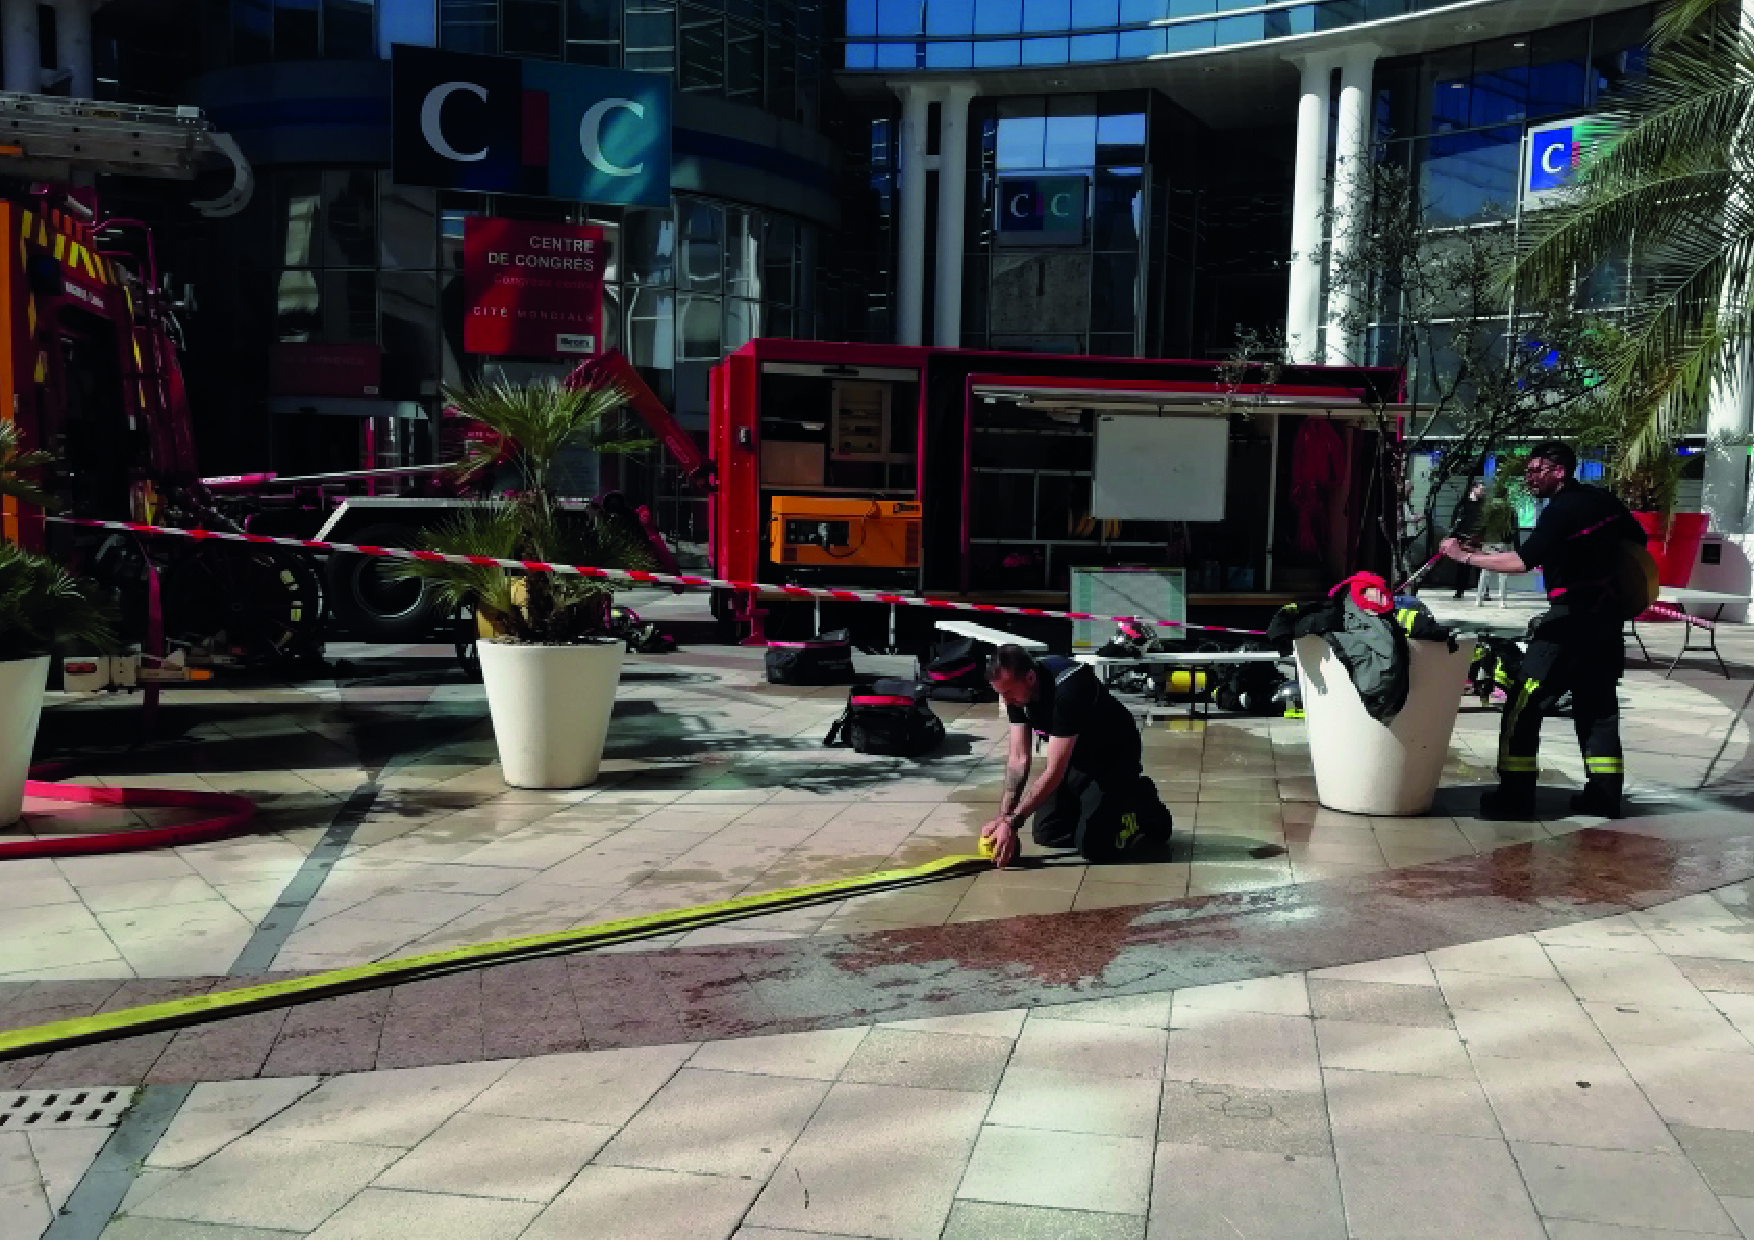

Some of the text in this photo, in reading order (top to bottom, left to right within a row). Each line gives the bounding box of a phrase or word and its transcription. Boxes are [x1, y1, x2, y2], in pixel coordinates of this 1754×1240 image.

[420, 81, 645, 177] CIC
[529, 236, 596, 254] CENTRE
[488, 252, 594, 272] DE CONGRÈS
